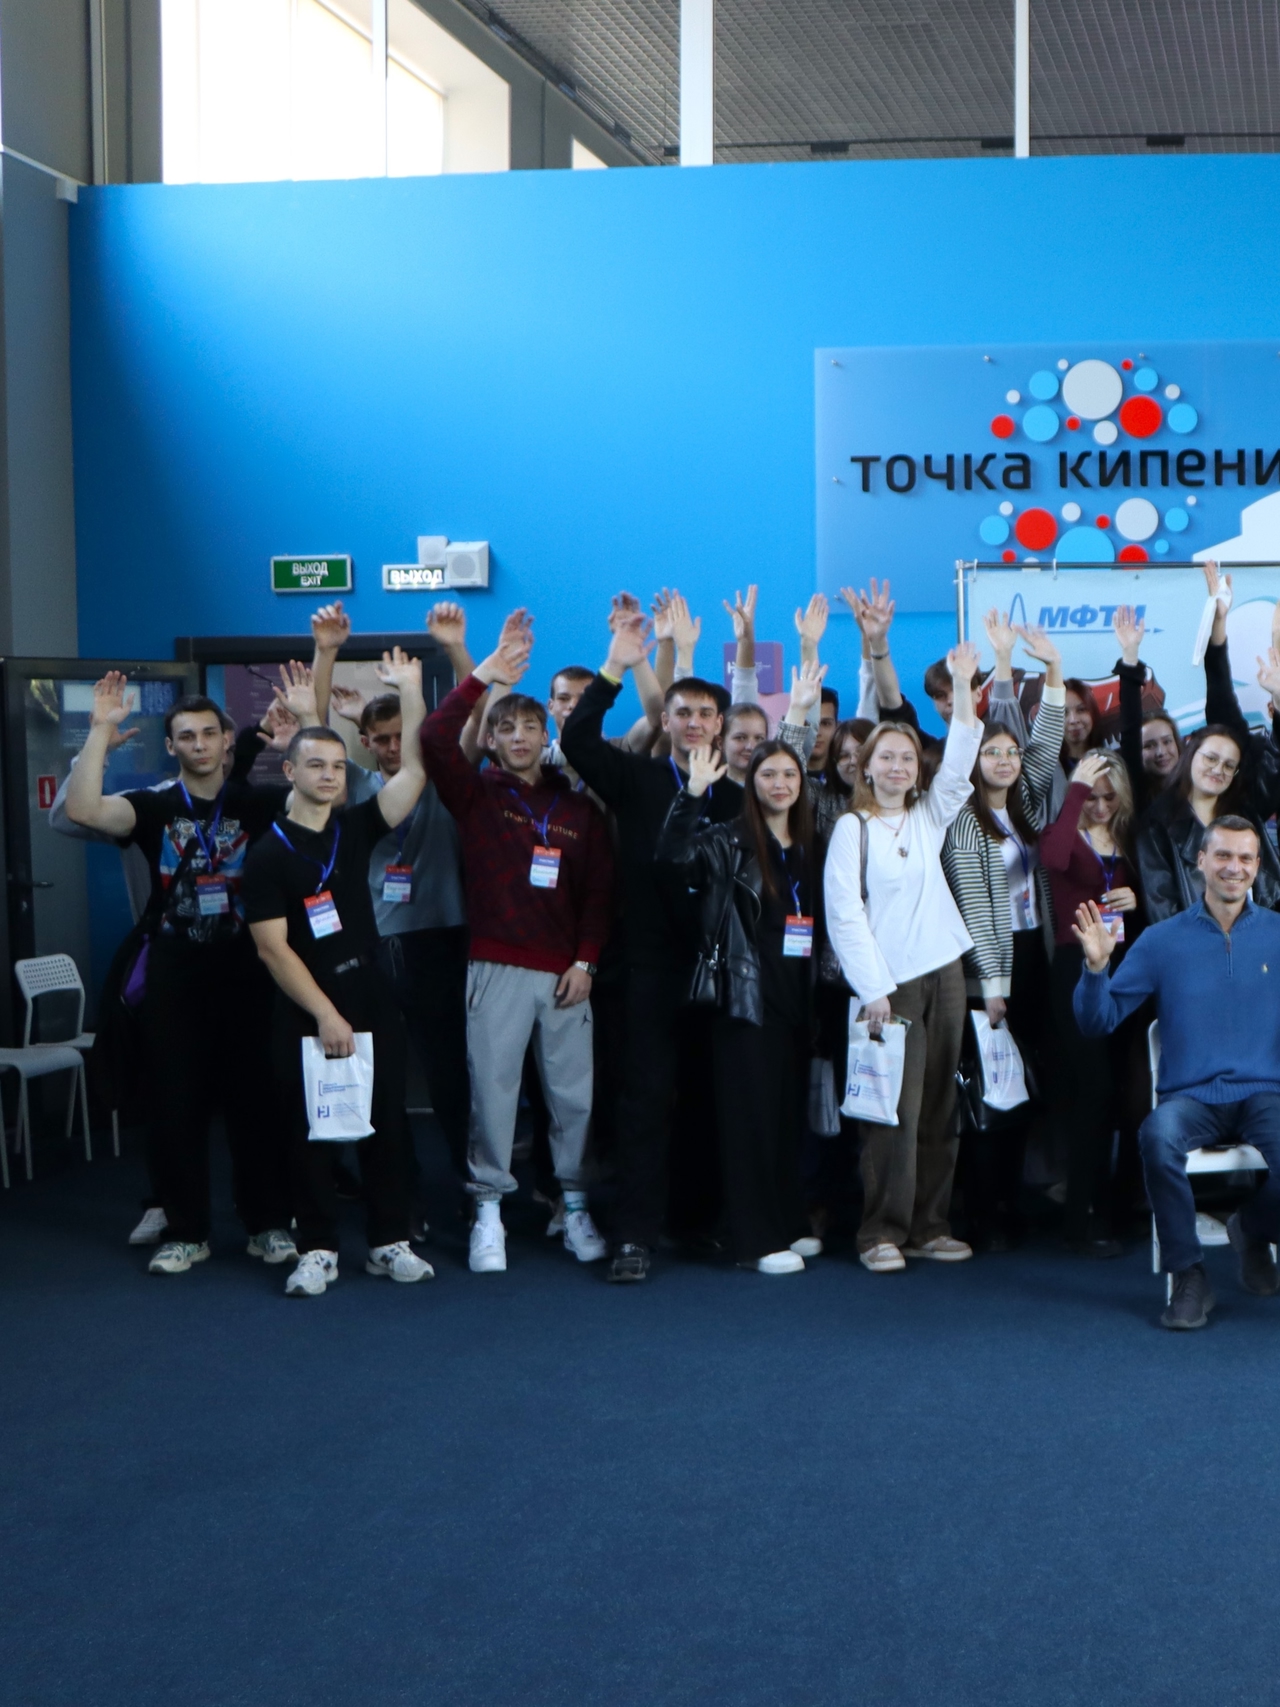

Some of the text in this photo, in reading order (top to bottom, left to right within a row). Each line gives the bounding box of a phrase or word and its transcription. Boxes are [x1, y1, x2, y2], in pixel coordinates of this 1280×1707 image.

[292, 561, 329, 577] ВЫХОД
[390, 569, 444, 585] ВЫХОД
[300, 575, 323, 586] EXIT
